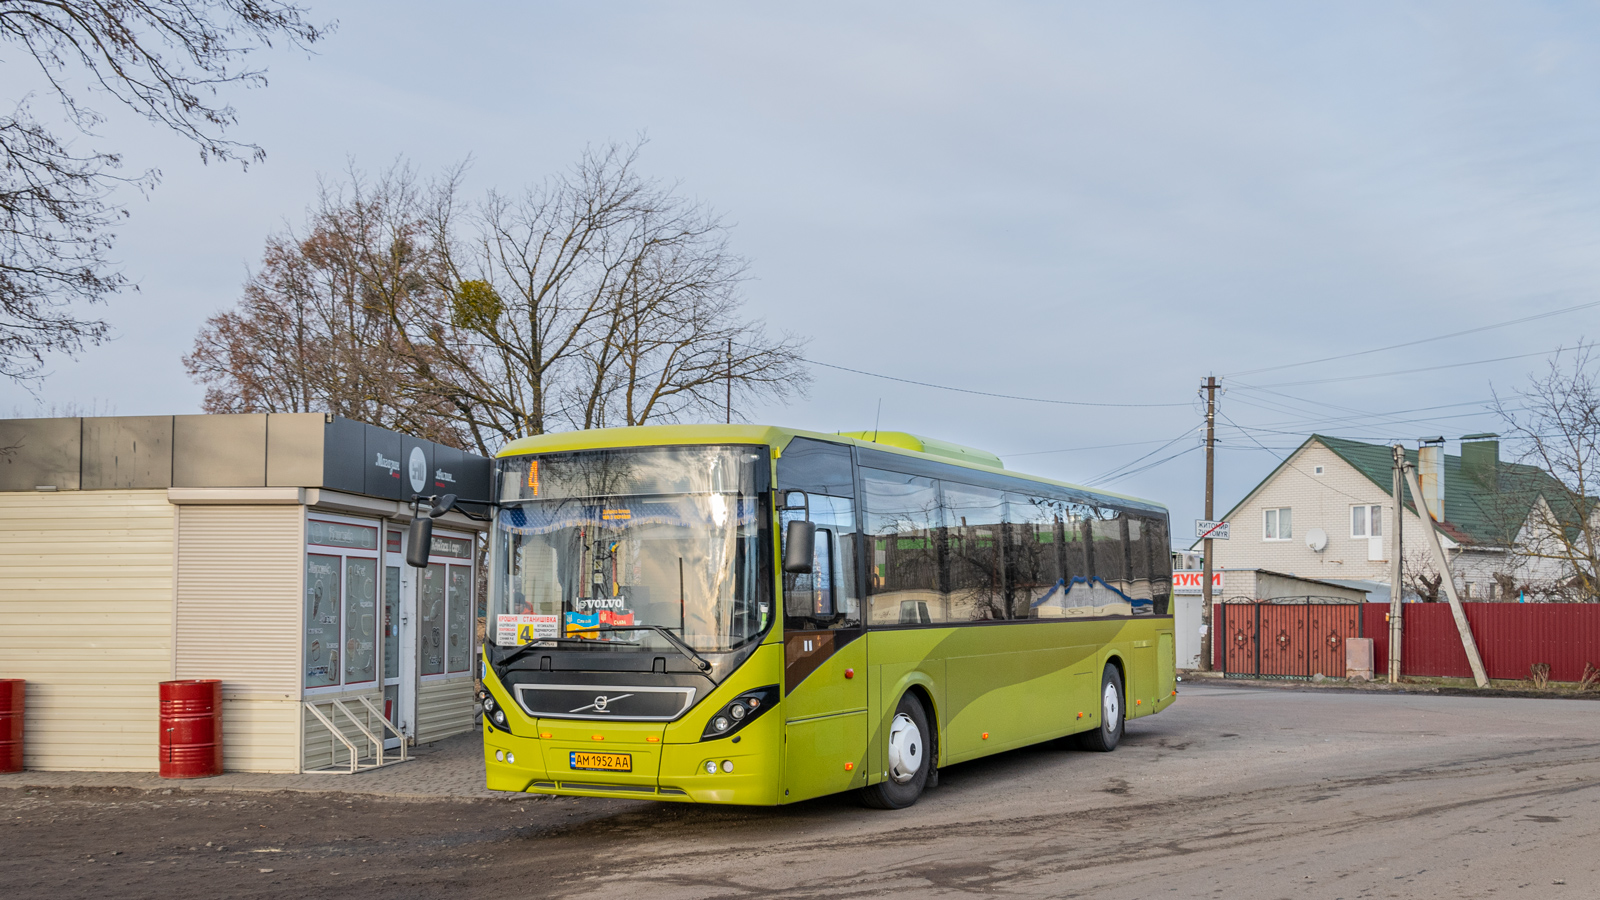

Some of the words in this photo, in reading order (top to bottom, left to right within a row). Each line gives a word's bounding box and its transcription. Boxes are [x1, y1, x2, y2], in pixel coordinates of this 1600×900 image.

[375, 452, 400, 475] Магазин
[528, 461, 539, 496] 4
[1198, 522, 1228, 530] ЖИТОМИР
[1173, 573, 1221, 586] ДУКИ
[587, 598, 622, 608] VOLVO
[520, 626, 531, 643] 4
[576, 755, 590, 766] AM
[591, 755, 613, 767] 1952
[615, 756, 629, 768] AA
